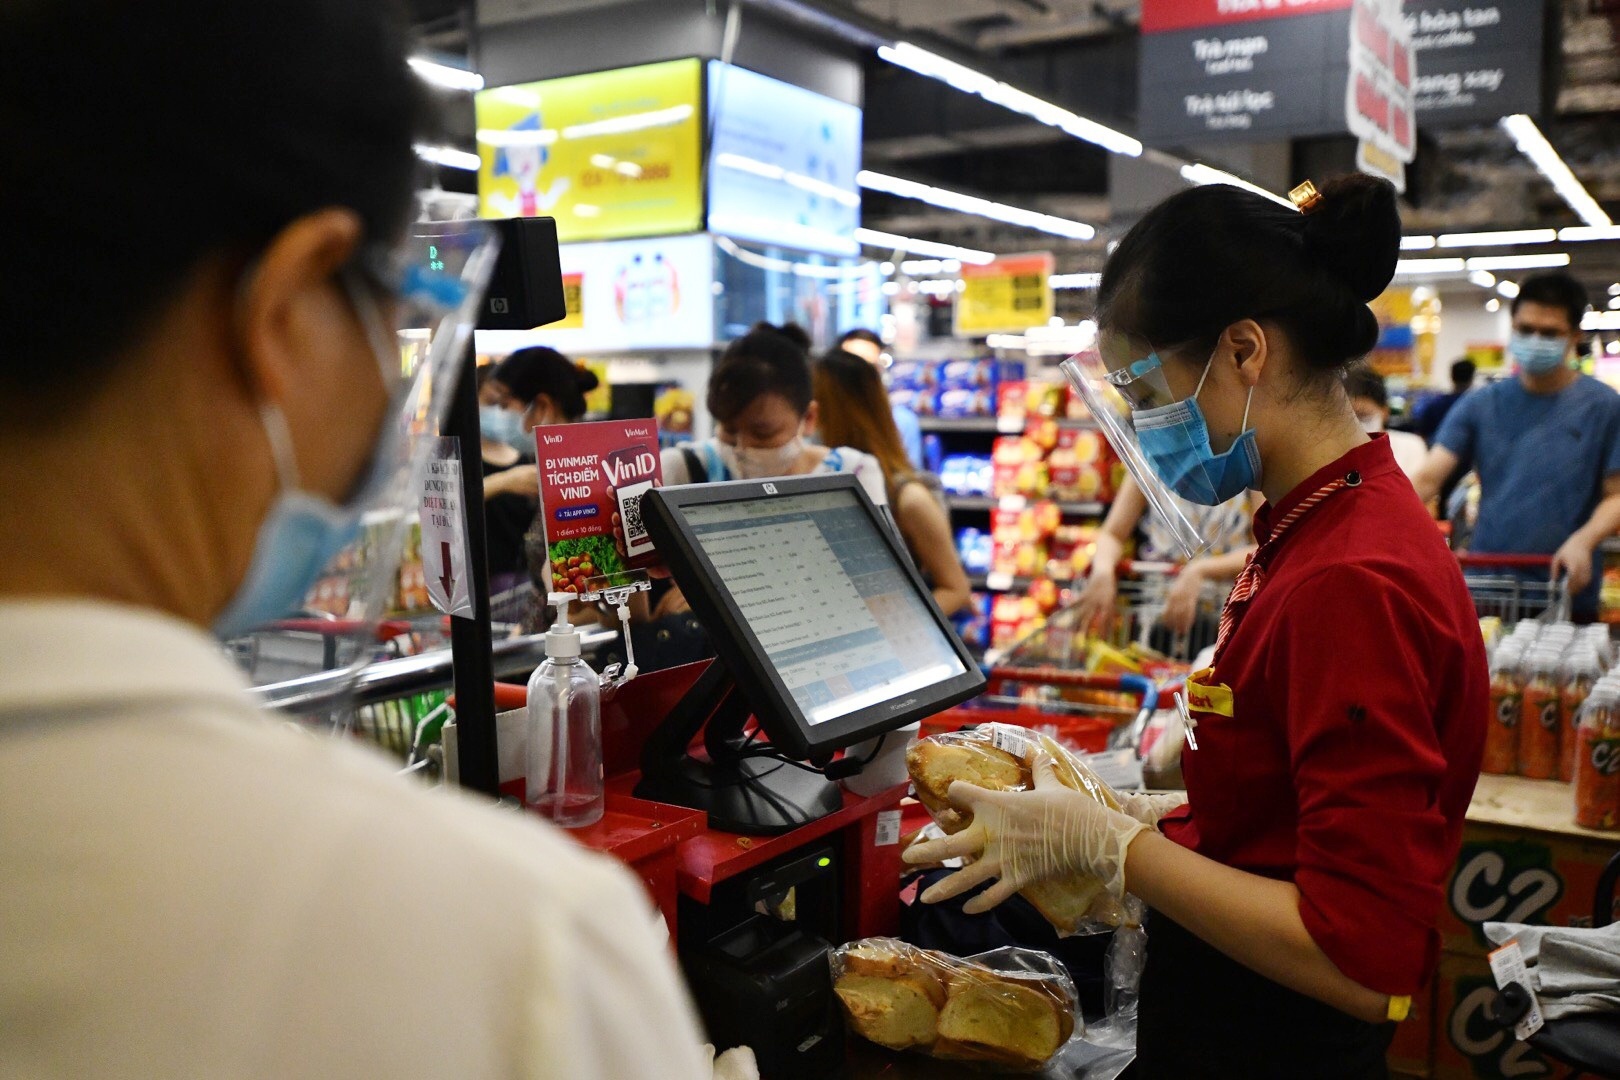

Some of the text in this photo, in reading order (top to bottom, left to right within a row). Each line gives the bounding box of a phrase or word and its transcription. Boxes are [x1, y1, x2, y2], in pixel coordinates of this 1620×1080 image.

[543, 428, 649, 445] VinID VinMart
[546, 455, 599, 469] ĐI VINMART
[601, 452, 656, 487] VinID
[547, 467, 600, 486] TÍCH ĐIỂM
[560, 486, 591, 500] VINID
[572, 509, 582, 517] APP
[1453, 851, 1558, 923] C2
